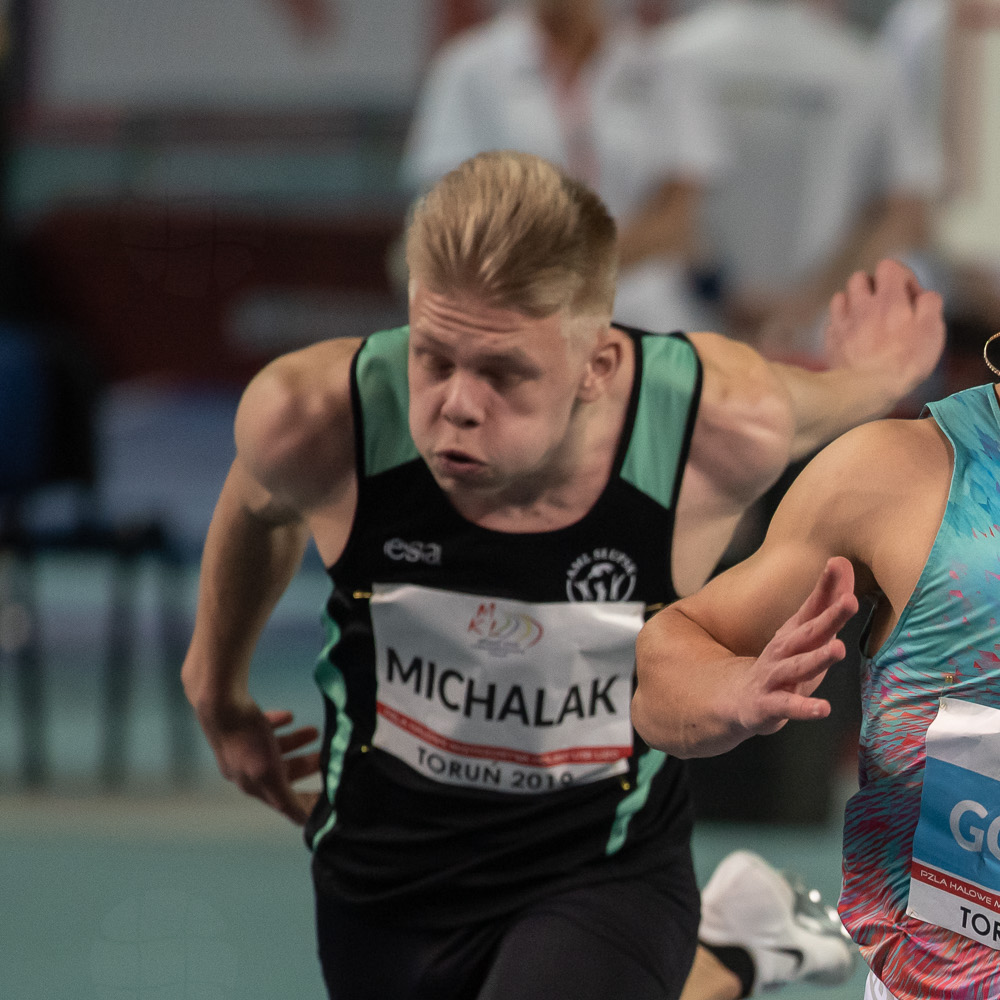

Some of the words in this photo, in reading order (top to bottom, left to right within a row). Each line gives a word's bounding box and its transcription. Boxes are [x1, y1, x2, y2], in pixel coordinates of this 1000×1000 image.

[383, 538, 442, 565] esa
[385, 647, 620, 728] MICHALAK
[920, 869, 948, 887] PZLA
[949, 881, 992, 906] HALOWE
